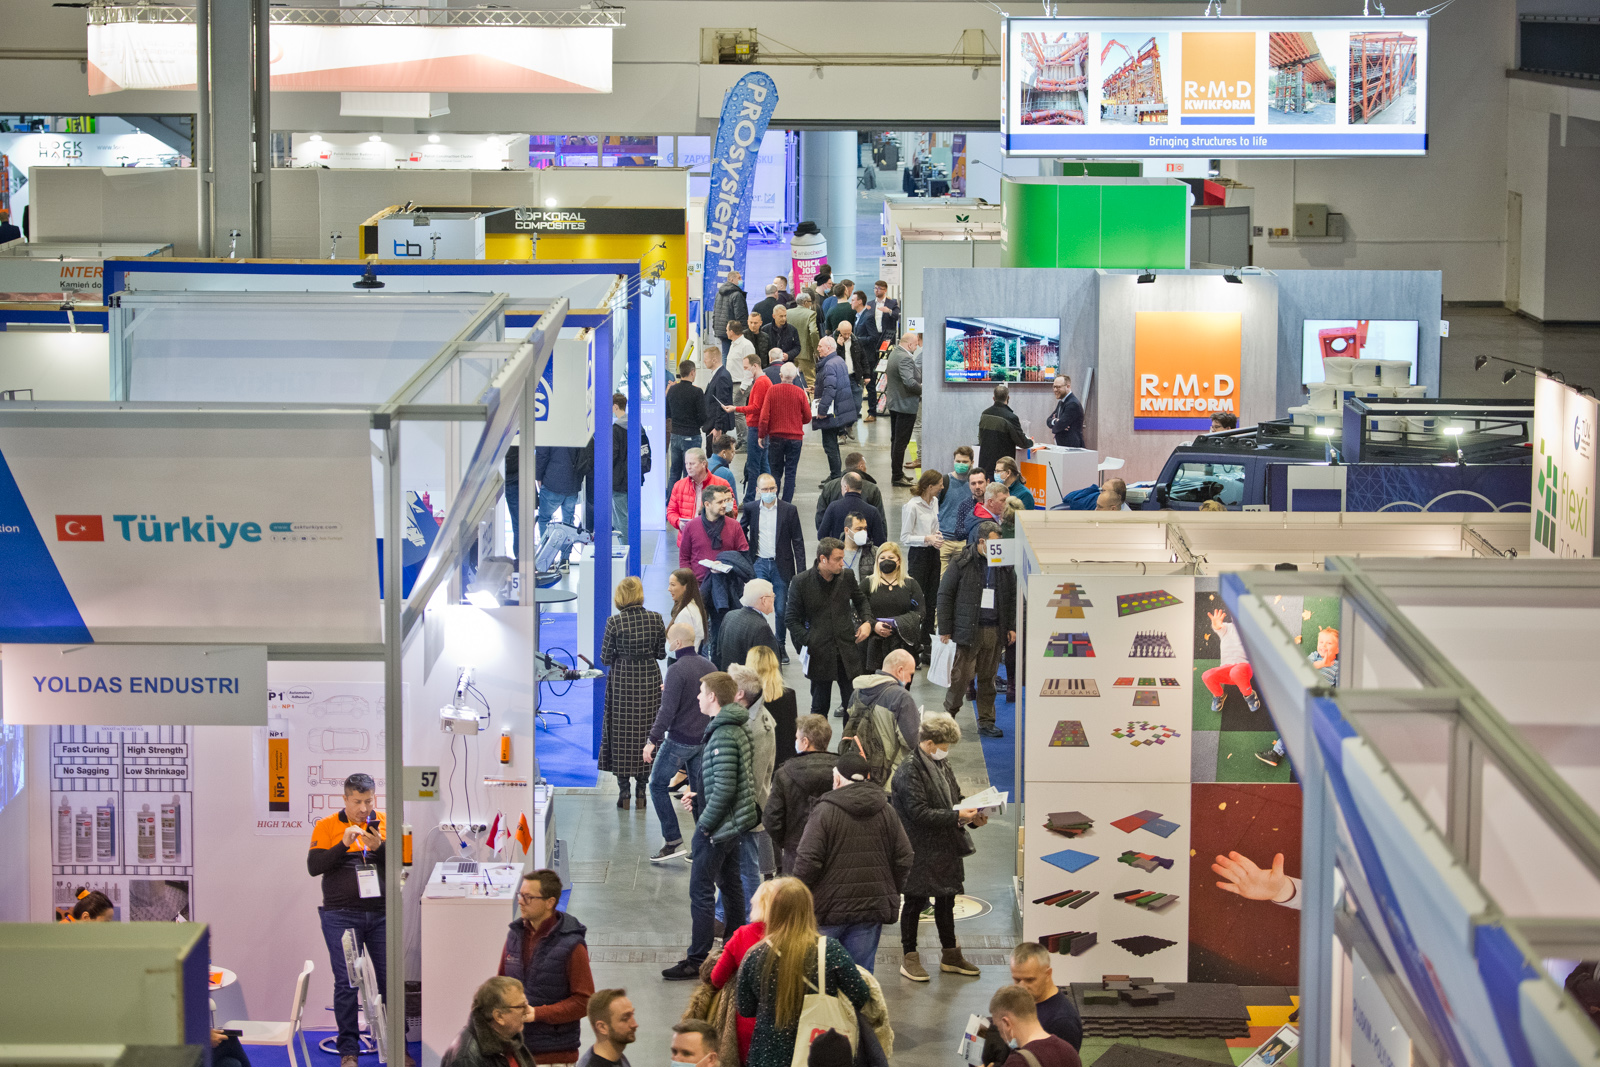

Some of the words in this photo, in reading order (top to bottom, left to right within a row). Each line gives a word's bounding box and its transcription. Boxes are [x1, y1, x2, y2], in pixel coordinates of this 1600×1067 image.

[1184, 99, 1252, 110] KWIKFORM
[39, 141, 83, 149] LOCK
[1149, 136, 1189, 148] Bringing
[1191, 136, 1237, 146] structures
[1240, 137, 1250, 146] to
[1252, 136, 1268, 146] life
[39, 150, 83, 158] HARD
[707, 82, 768, 254] PROsystem
[543, 213, 586, 221] KORAL
[515, 222, 586, 230] COMPOSITES
[797, 260, 820, 268] QUICK
[1141, 398, 1234, 412] KWIKFORM
[113, 514, 262, 549] Türkiye
[990, 544, 1002, 556] 55
[33, 676, 123, 693] YOLDAS
[129, 677, 239, 694] ENDUSTRI
[82, 746, 110, 755] Curing
[127, 746, 146, 755] High
[148, 746, 184, 755] Strength
[63, 767, 74, 775] No
[76, 767, 110, 775] Sagging
[125, 767, 142, 775] Low
[144, 767, 186, 776] Shrinkage
[421, 771, 438, 787] 57
